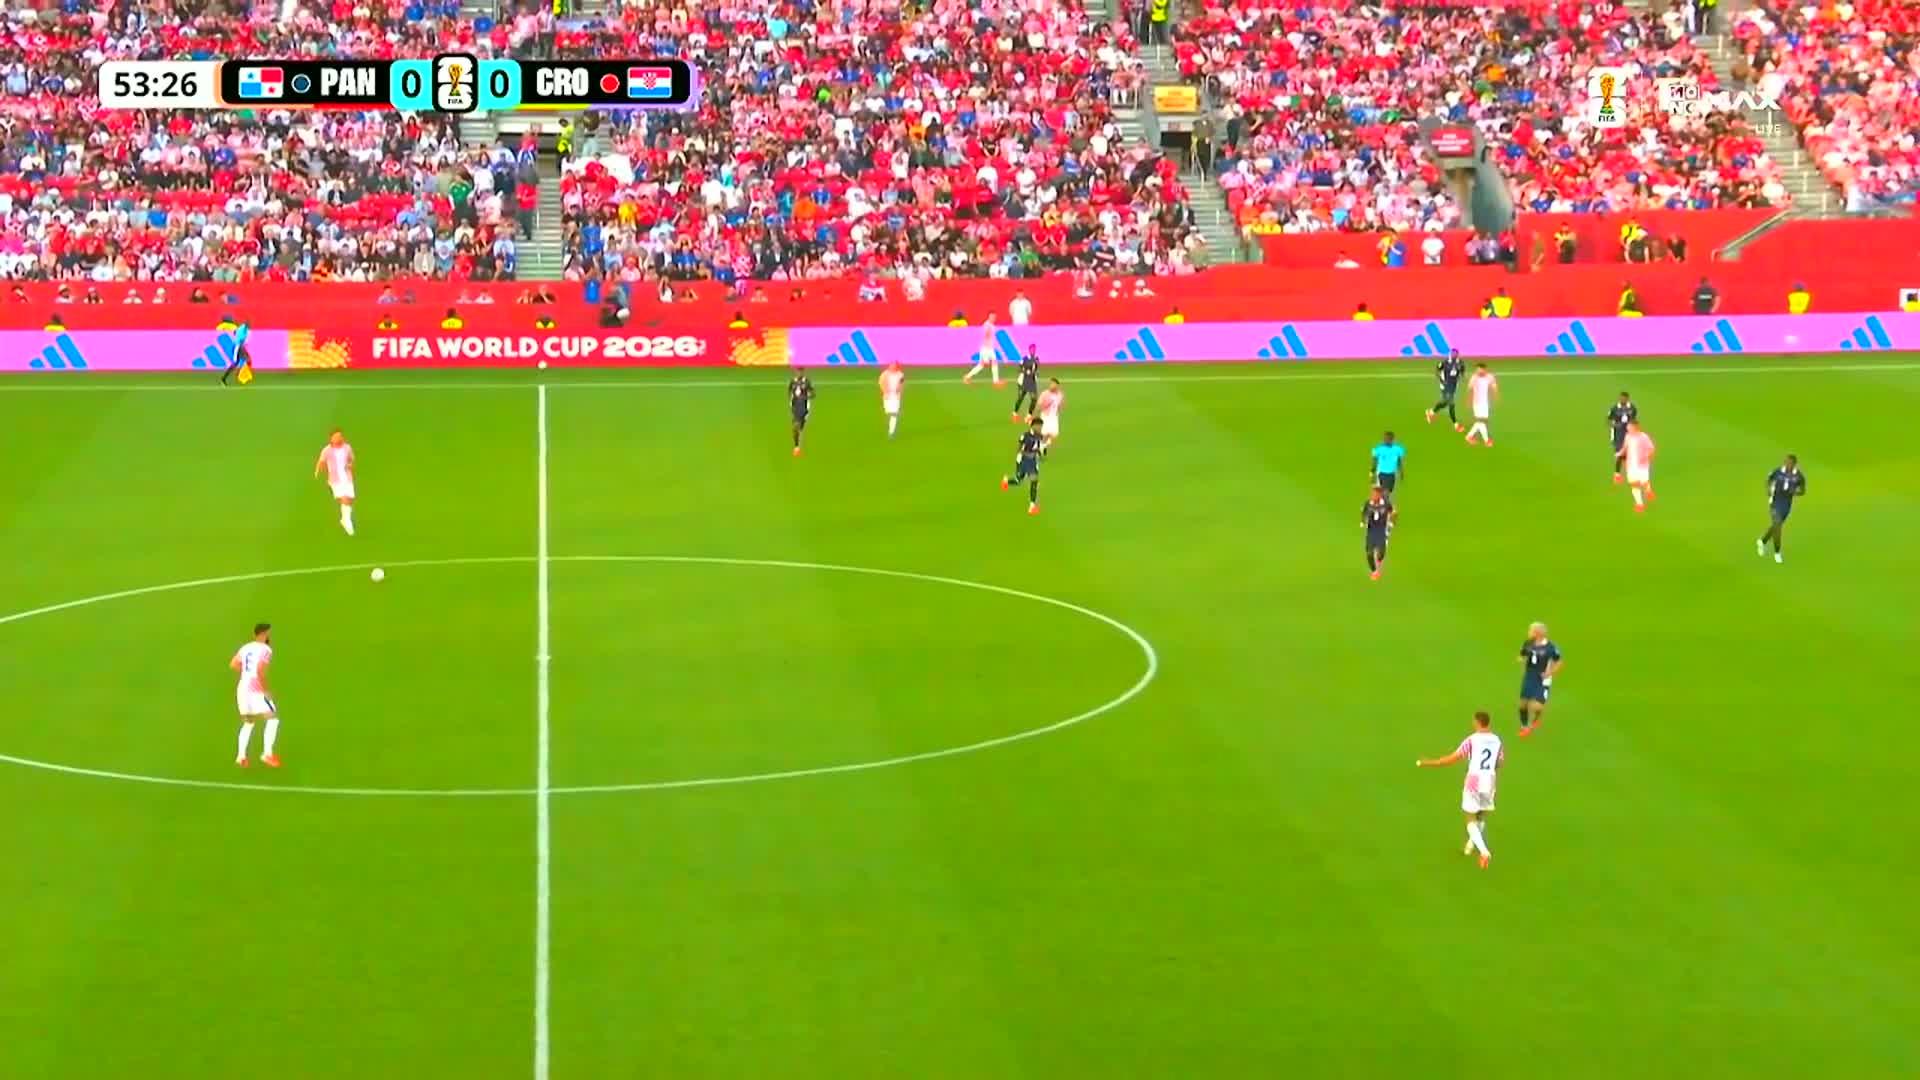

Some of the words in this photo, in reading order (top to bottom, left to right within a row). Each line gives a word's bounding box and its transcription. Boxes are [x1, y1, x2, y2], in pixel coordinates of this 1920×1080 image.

[372, 337, 433, 359] FIFA
[436, 336, 538, 358] WORLD
[543, 336, 599, 357] CUP
[602, 336, 699, 358] 2026
[1480, 748, 1491, 770] 2
